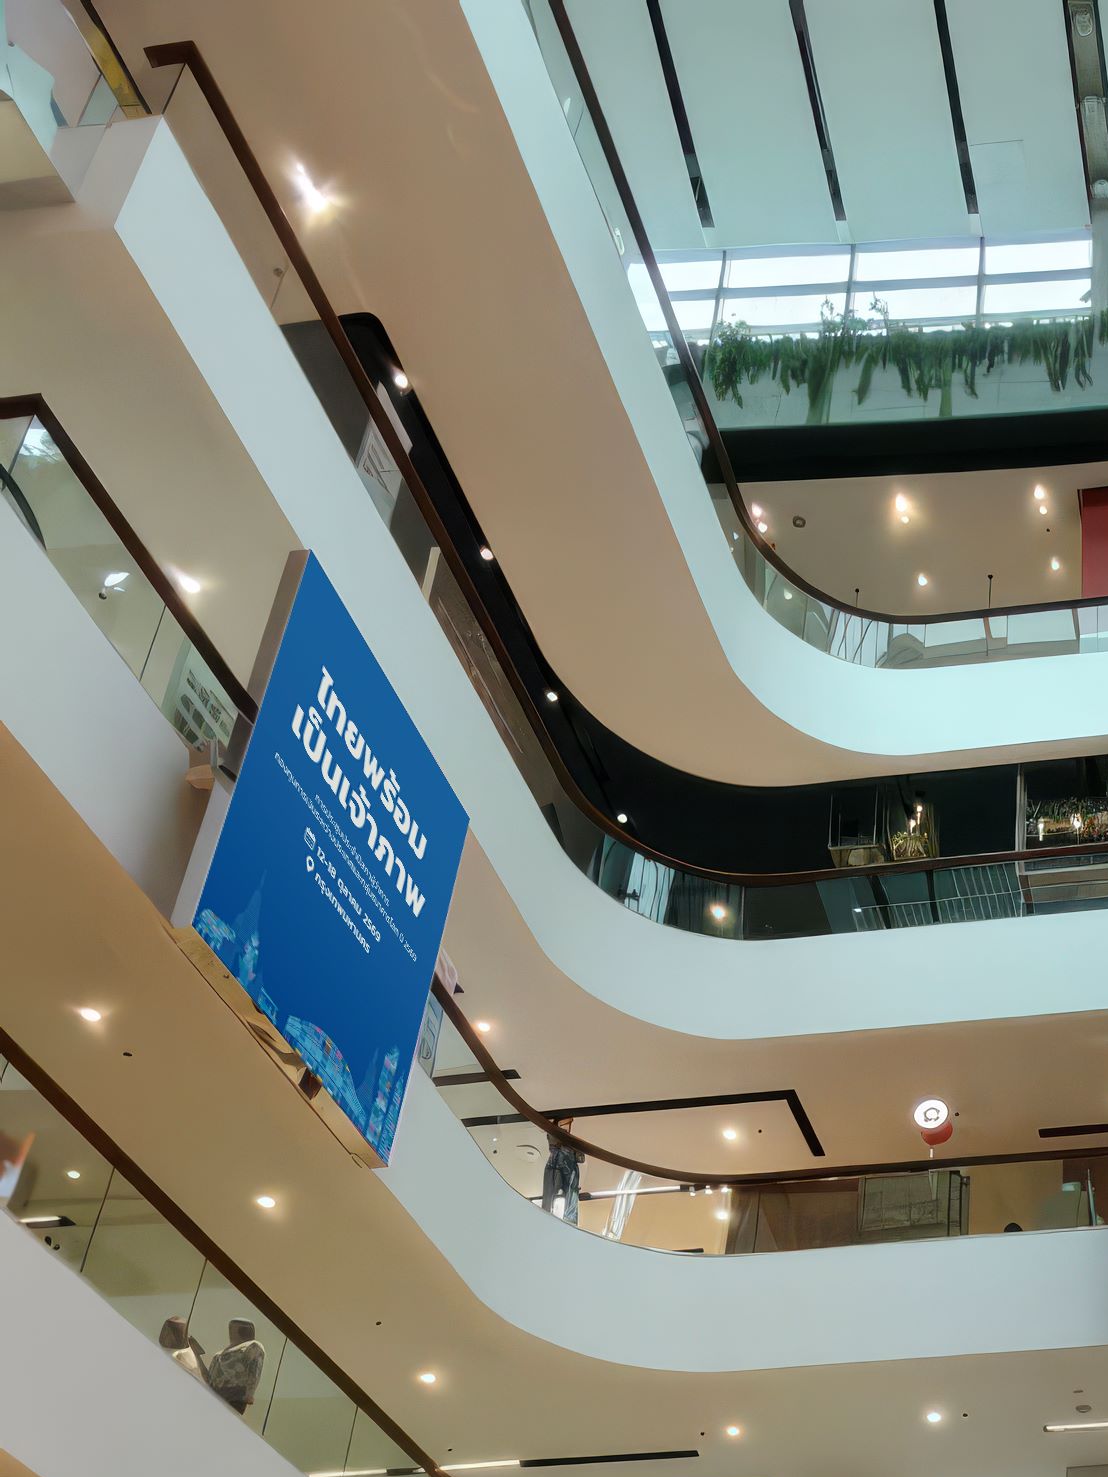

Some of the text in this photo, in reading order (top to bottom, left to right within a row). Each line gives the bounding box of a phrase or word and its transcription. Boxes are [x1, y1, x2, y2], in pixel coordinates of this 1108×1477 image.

[291, 703, 425, 917] เป็นเจ้าภาพ
[317, 665, 427, 859] ไทยพร้อม
